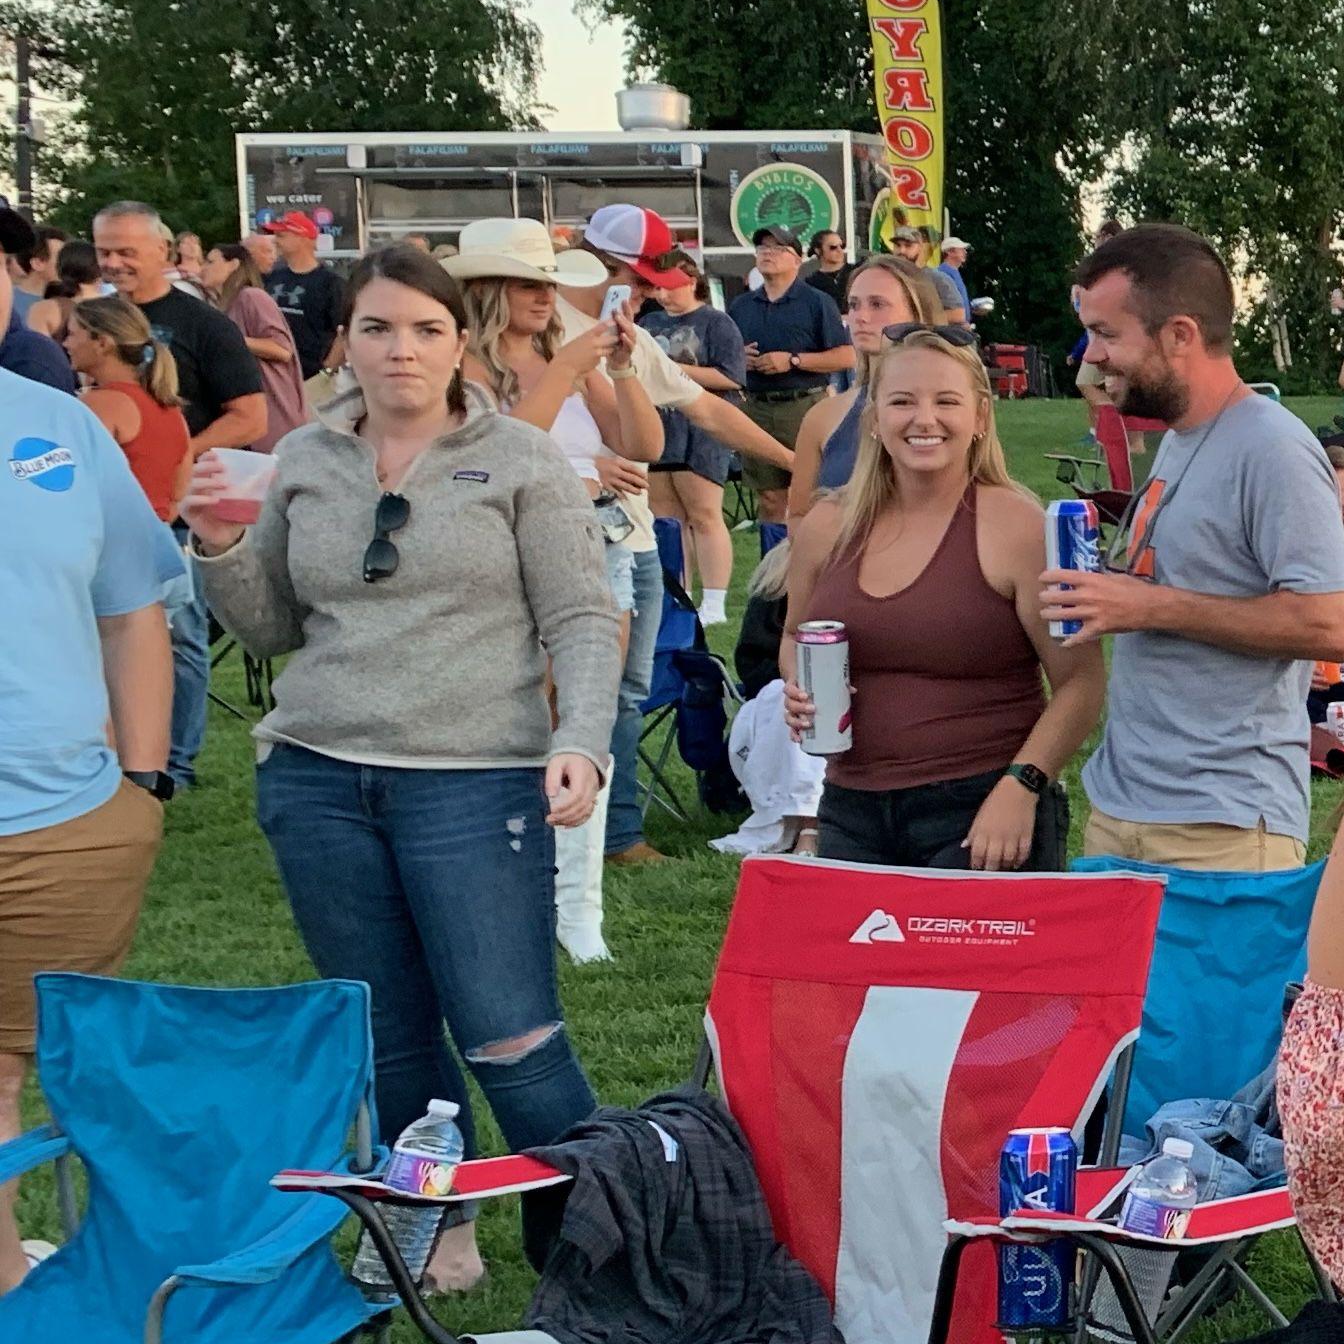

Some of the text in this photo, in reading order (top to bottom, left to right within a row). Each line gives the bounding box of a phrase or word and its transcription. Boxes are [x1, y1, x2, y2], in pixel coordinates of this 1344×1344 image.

[266, 194, 322, 204] we cater
[907, 916, 1035, 936] OZARK TRAIL
[918, 935, 1019, 946] OUTDOOR EQUIPMENT
